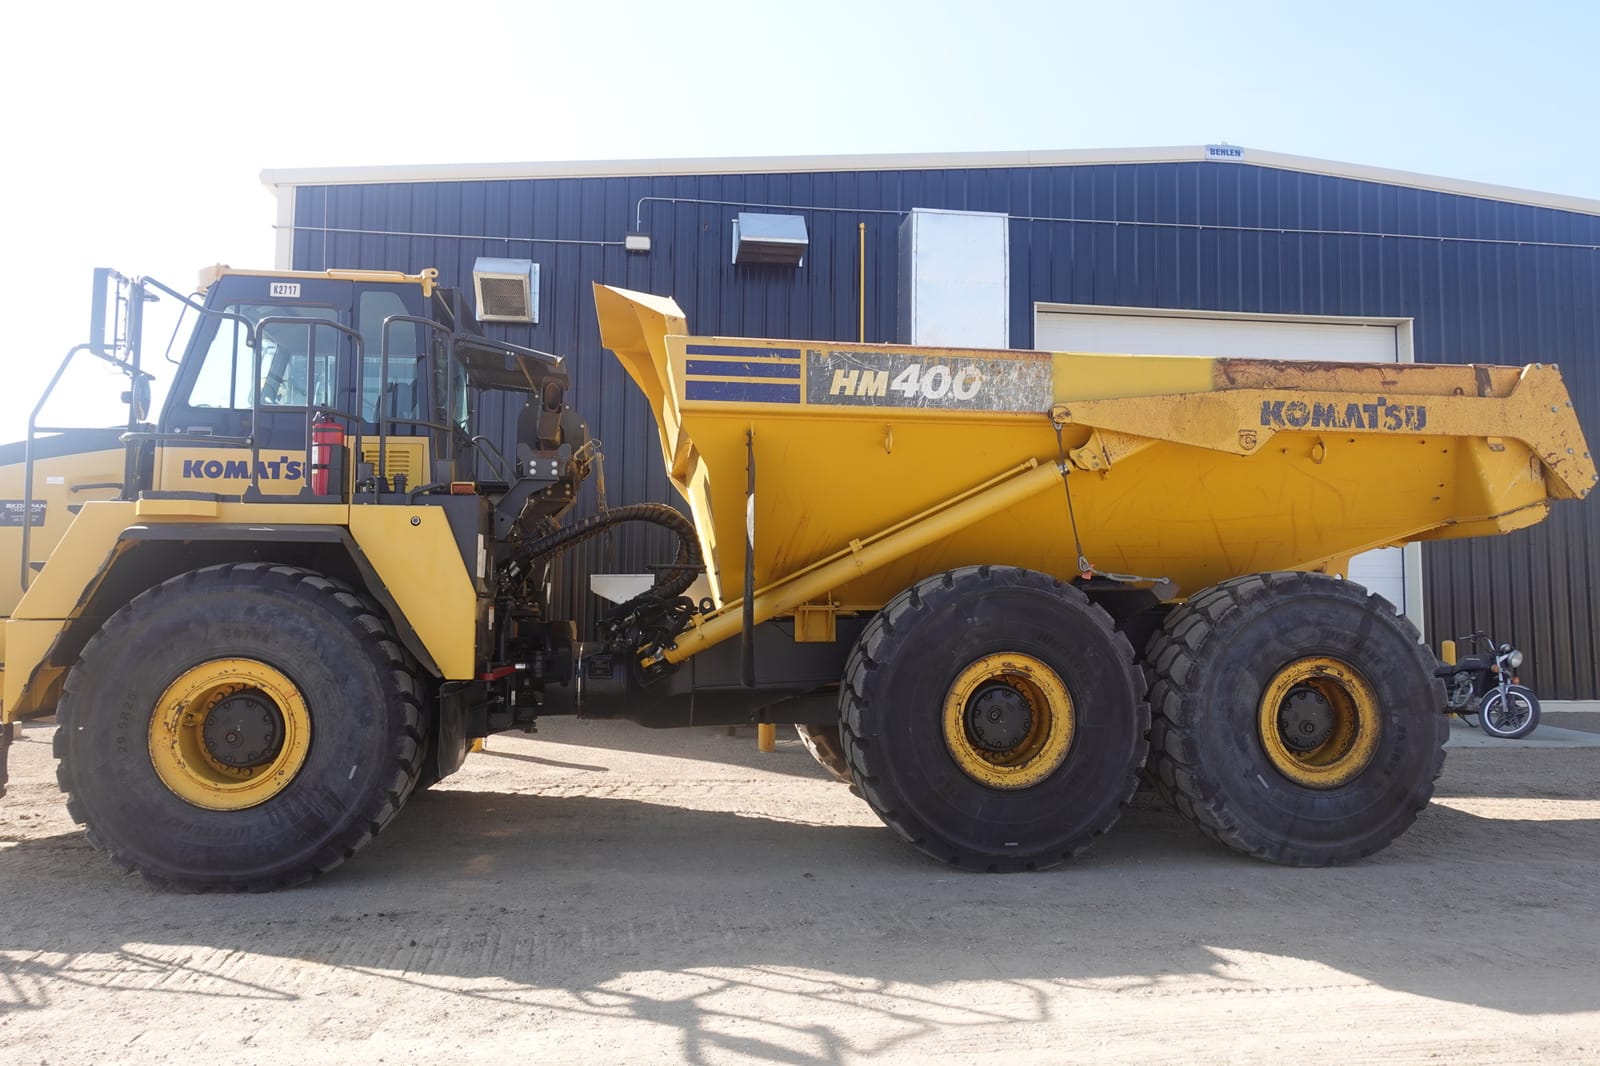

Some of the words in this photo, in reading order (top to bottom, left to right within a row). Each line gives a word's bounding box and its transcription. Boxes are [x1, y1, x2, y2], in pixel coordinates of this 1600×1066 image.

[1209, 147, 1241, 157] BEHLEN
[273, 284, 297, 295] K2717
[1260, 396, 1427, 431] KOMATSU
[182, 455, 306, 481] KOMATS
